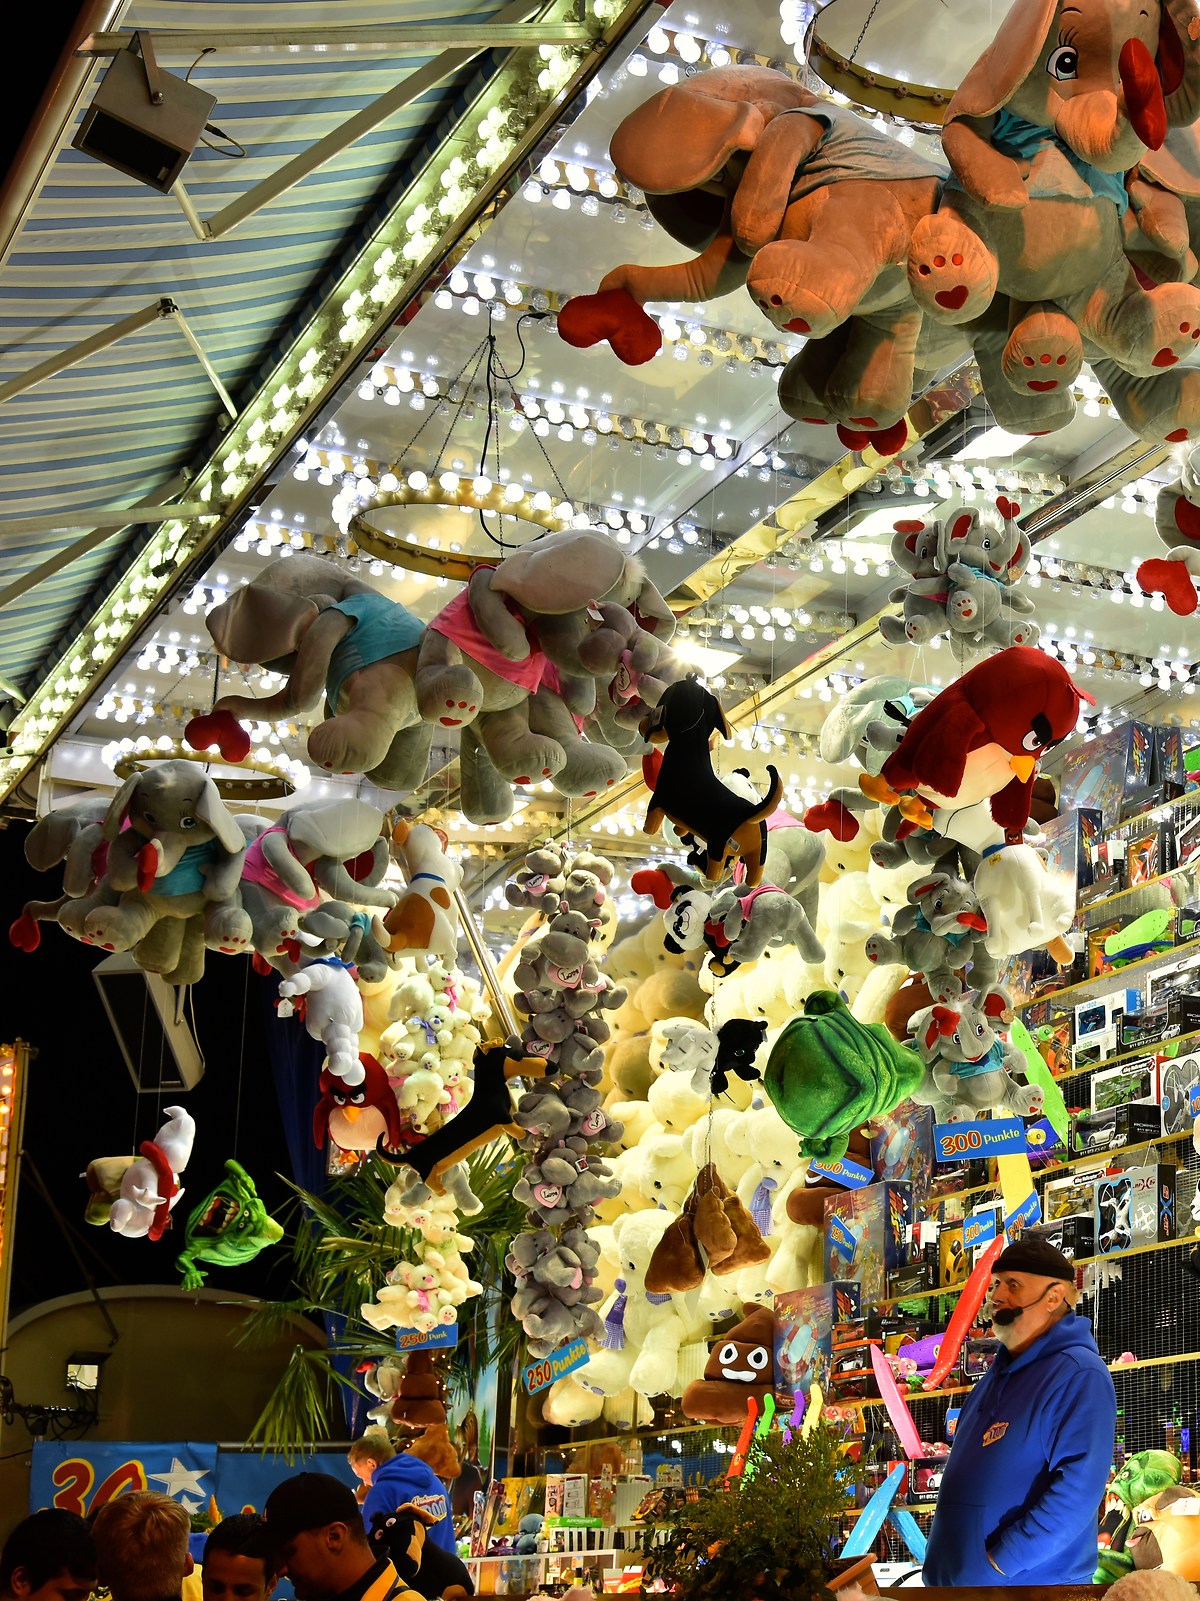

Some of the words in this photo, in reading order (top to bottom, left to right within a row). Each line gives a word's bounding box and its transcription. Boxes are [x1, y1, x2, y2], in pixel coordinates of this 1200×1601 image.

[940, 1130, 982, 1156] 300
[983, 1129, 1020, 1144] Punkte
[842, 1168, 867, 1182] Punkte
[965, 1221, 980, 1243] 300
[400, 1331, 428, 1348] 250
[527, 1359, 553, 1391] 250
[552, 1342, 587, 1374] Punkte
